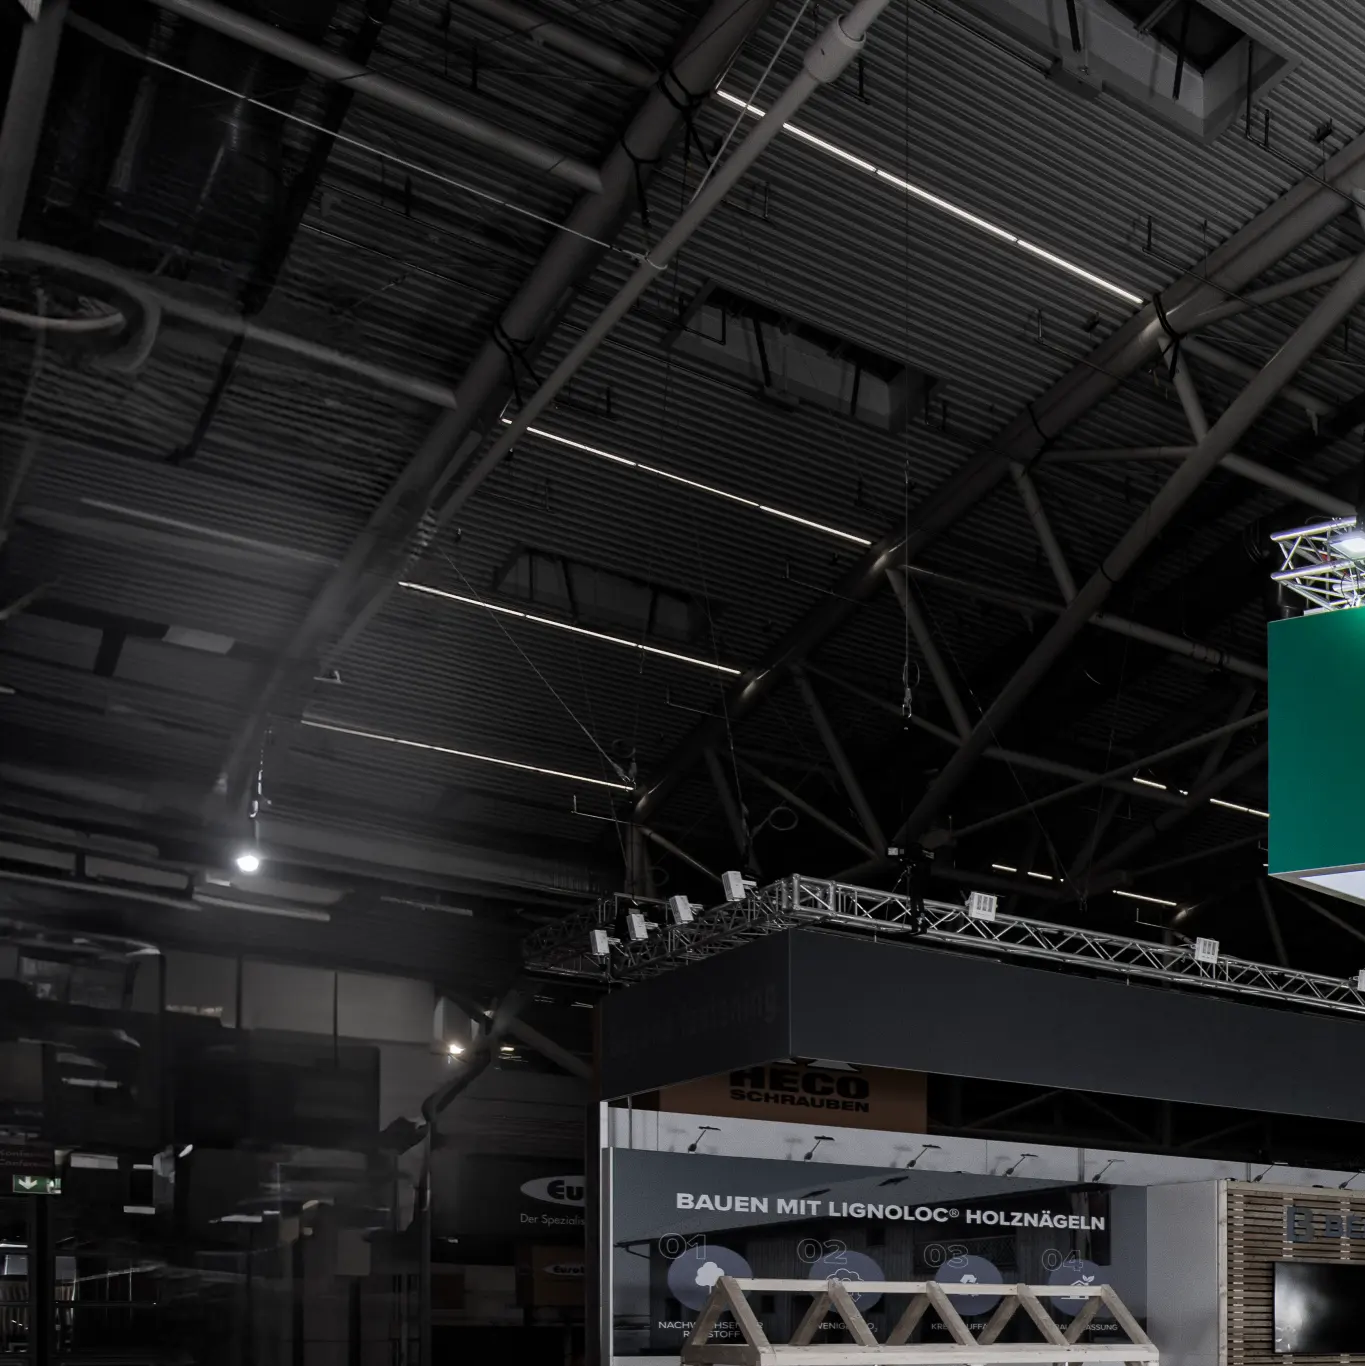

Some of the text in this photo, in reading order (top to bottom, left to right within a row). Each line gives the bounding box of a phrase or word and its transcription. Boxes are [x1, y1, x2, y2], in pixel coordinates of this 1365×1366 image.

[730, 1067, 870, 1098] HECO
[730, 1089, 870, 1113] SCHRAUBEN
[520, 1213, 539, 1224] Der
[676, 1192, 1106, 1231] BAUEN MIT LIGNOLOC® HOLZNÄGELN
[658, 1232, 707, 1260] 01
[797, 1238, 848, 1265] 02
[923, 1243, 970, 1269] 03
[1041, 1248, 1085, 1272] 04
